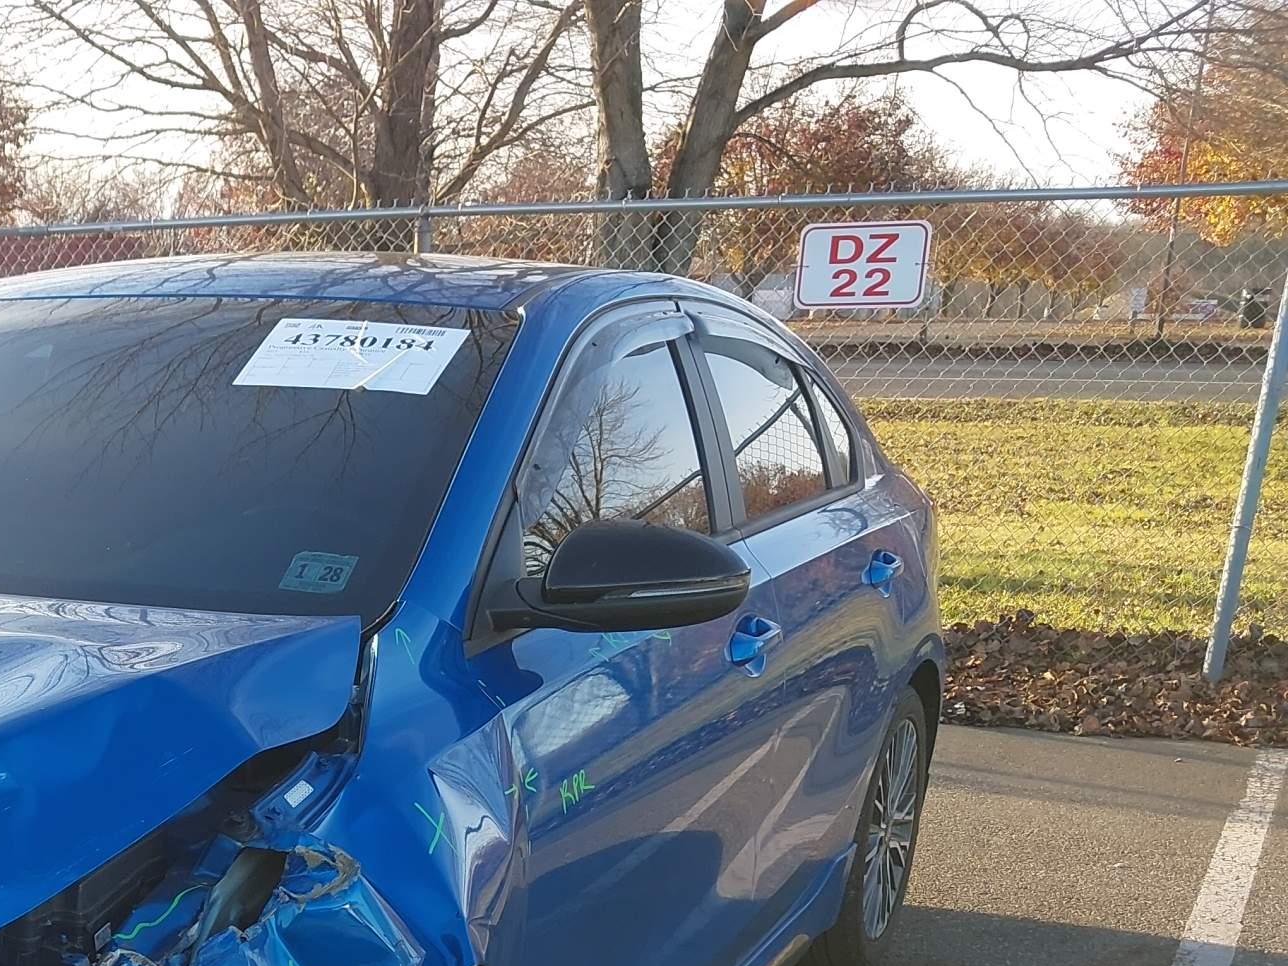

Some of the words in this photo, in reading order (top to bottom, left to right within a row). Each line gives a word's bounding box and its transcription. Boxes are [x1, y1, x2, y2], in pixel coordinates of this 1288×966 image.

[828, 233, 900, 265] DZ
[829, 267, 891, 297] 22
[283, 332, 435, 352] 43780184
[295, 562, 309, 579] 1
[318, 565, 344, 582] 28
